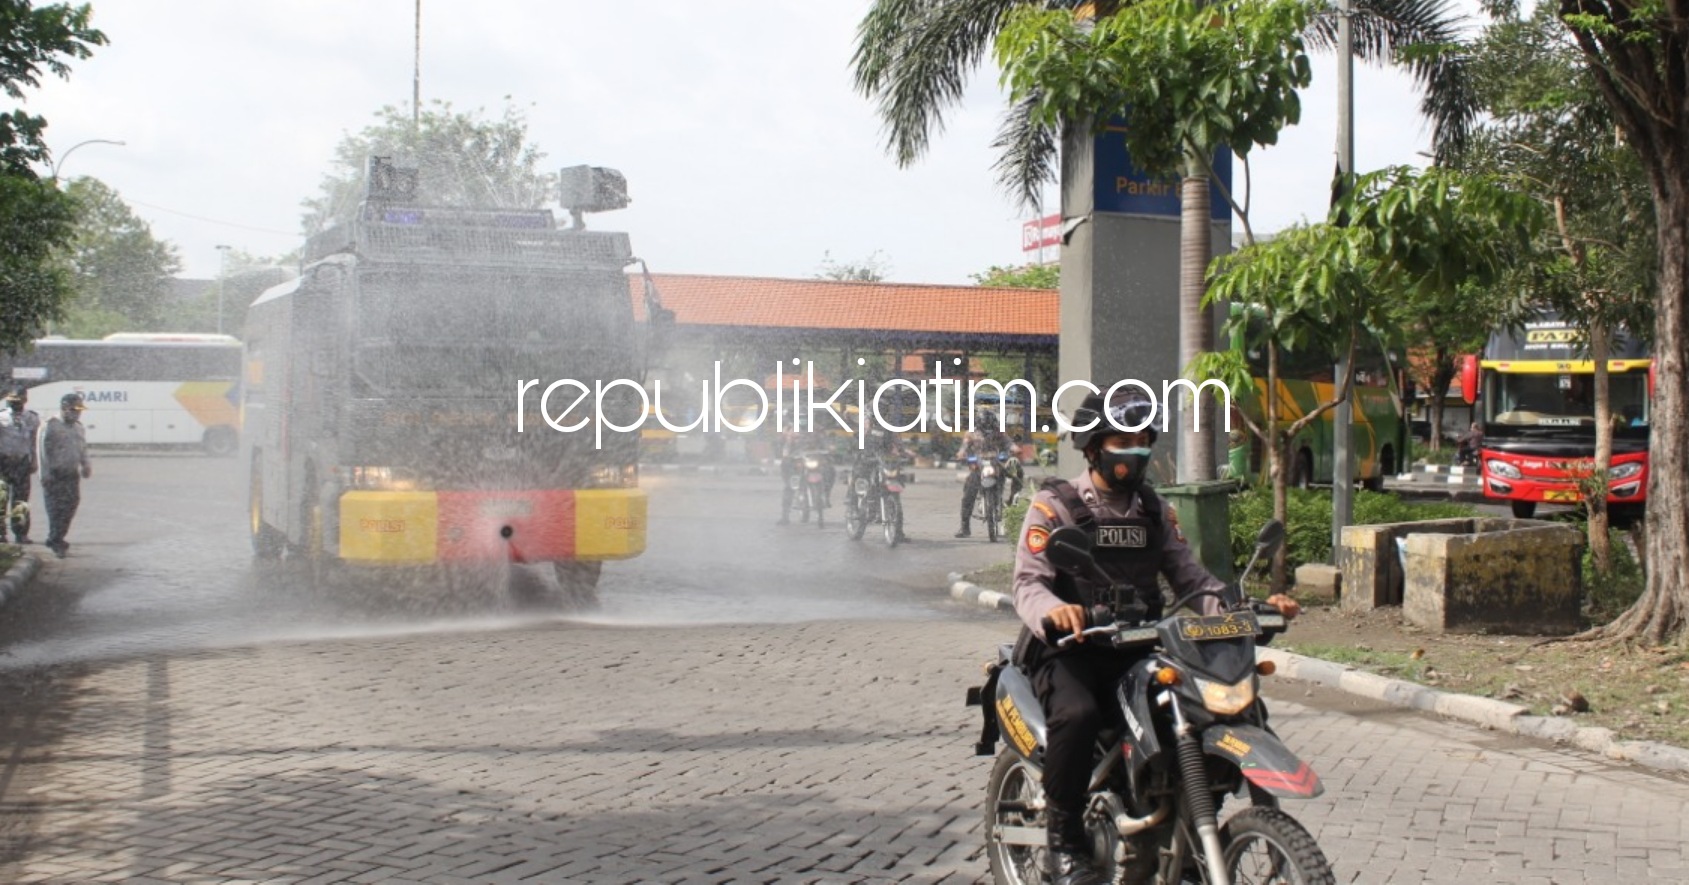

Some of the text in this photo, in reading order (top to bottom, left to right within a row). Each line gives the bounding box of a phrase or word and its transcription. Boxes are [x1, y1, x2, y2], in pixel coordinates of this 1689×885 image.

[1115, 176, 1170, 198] Parkir
[76, 390, 129, 402] DAMRI
[1099, 528, 1144, 545] POLISI
